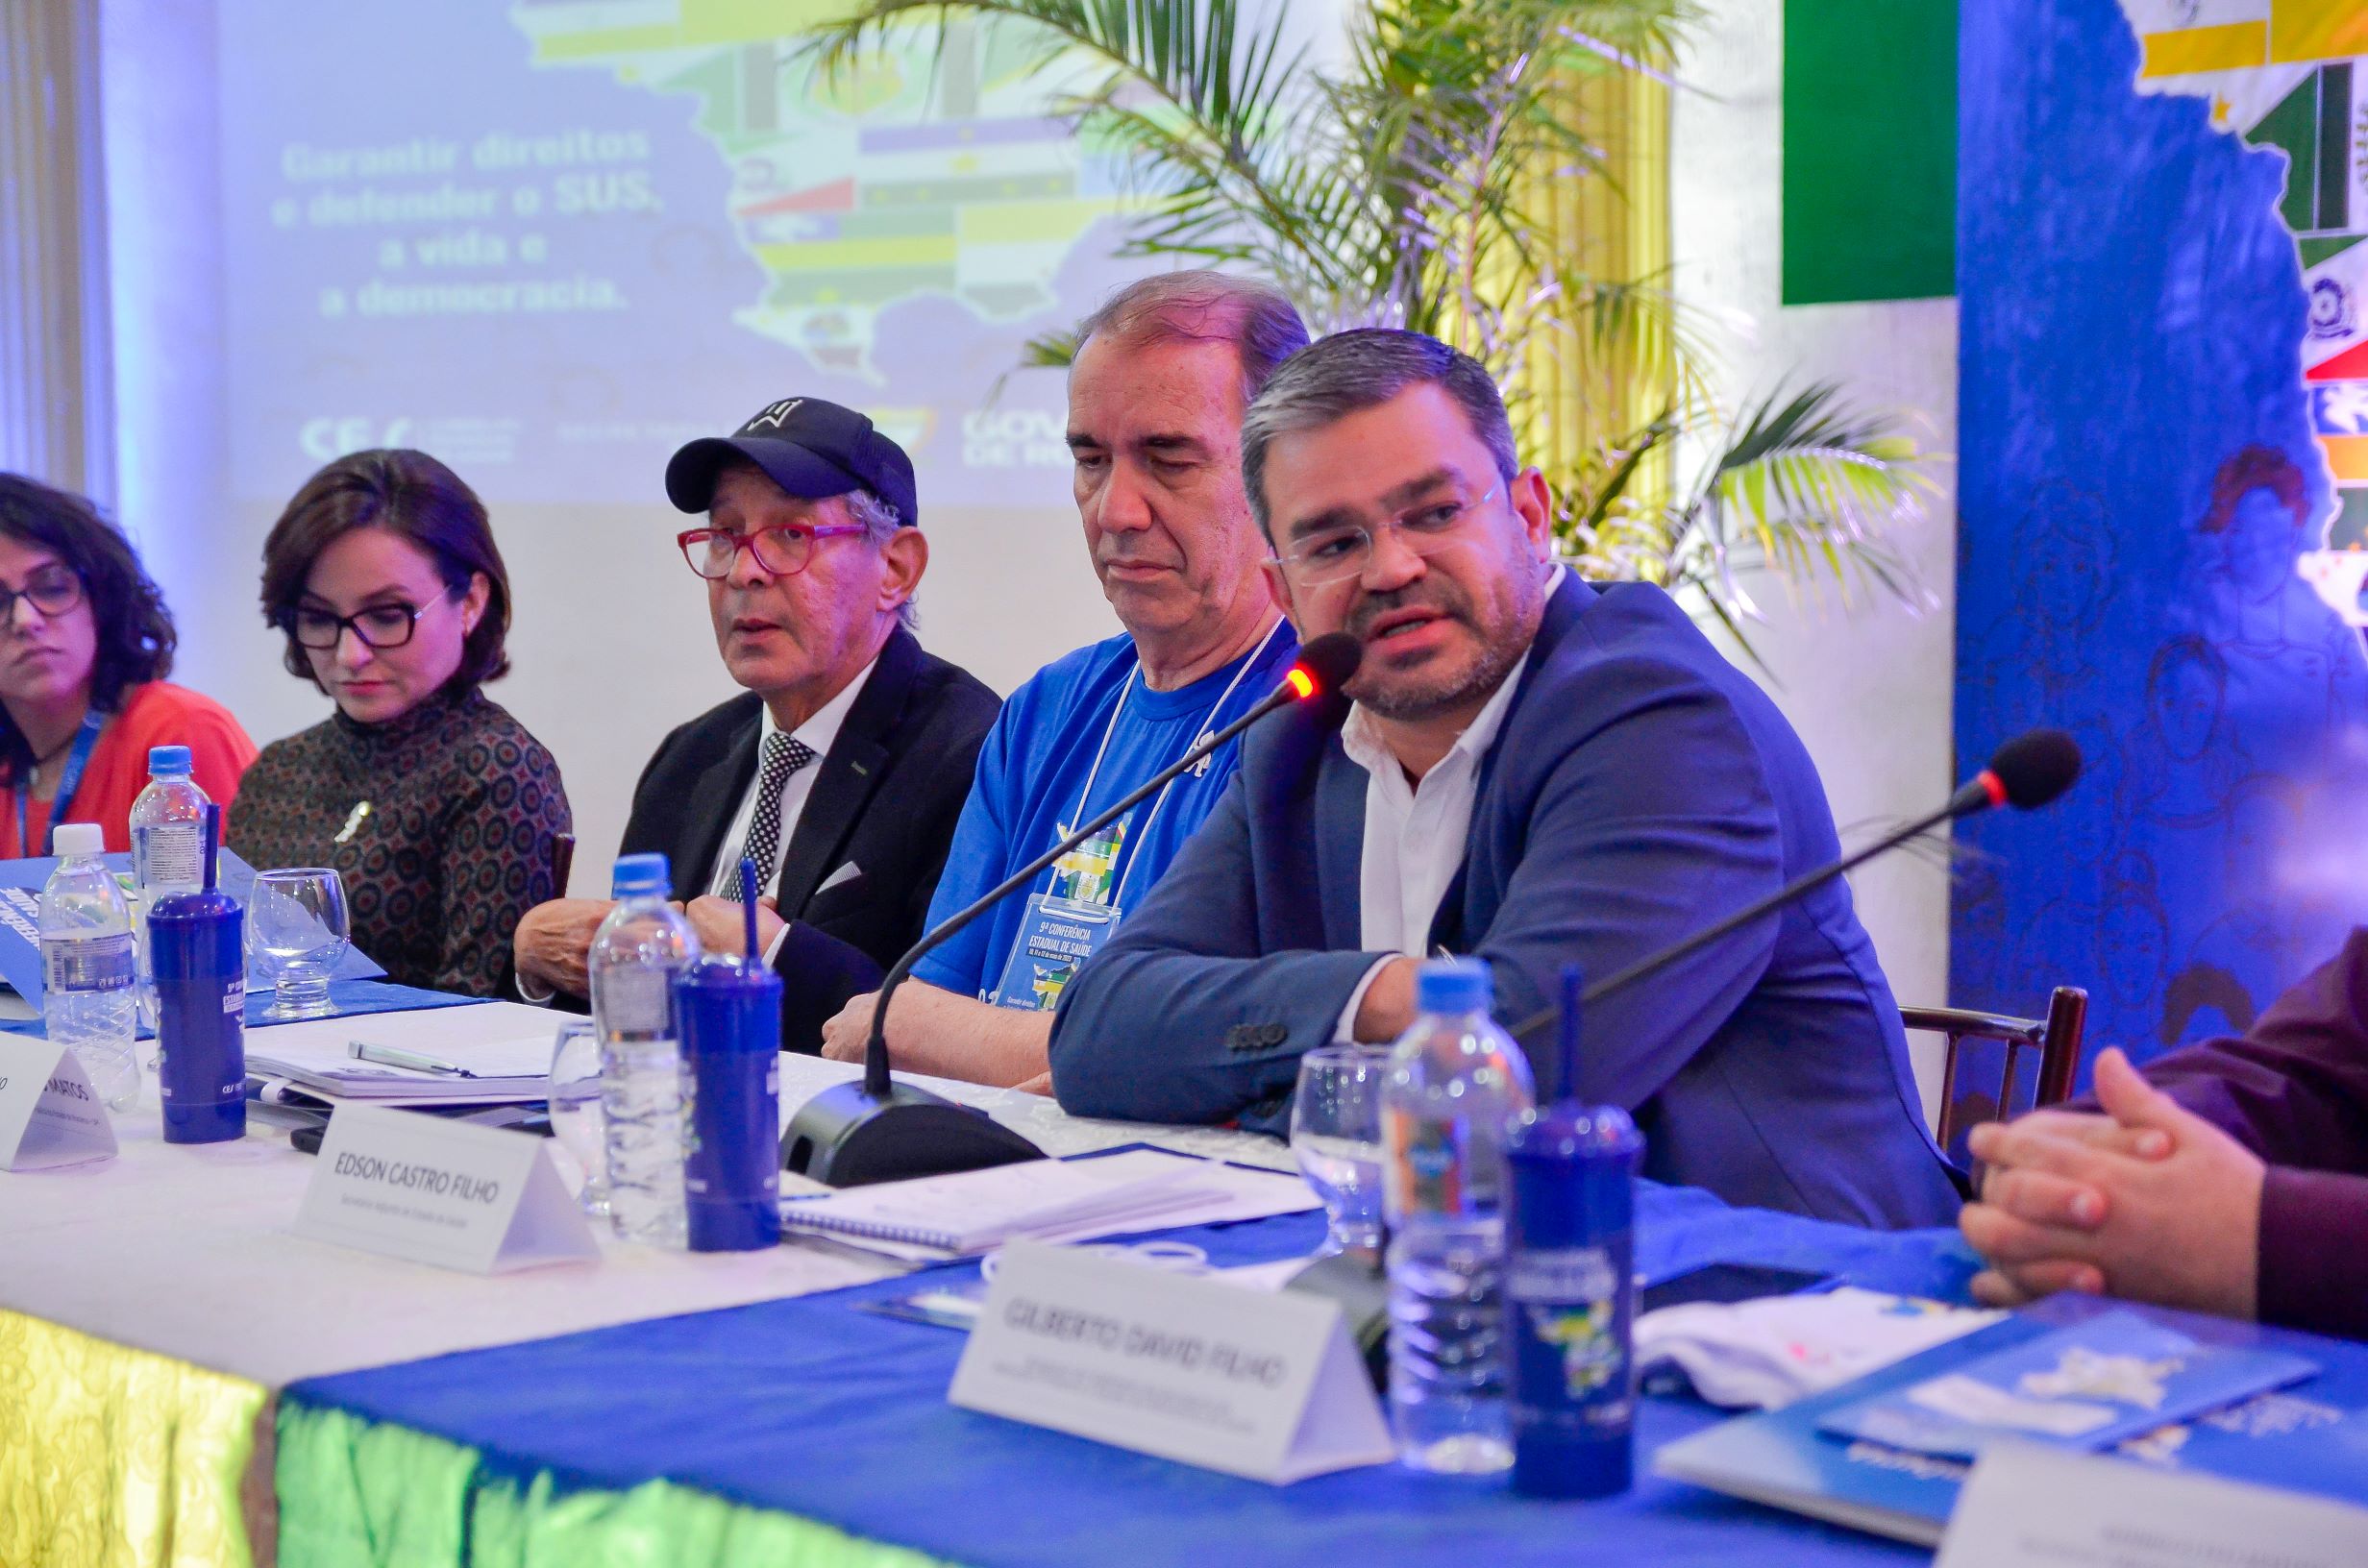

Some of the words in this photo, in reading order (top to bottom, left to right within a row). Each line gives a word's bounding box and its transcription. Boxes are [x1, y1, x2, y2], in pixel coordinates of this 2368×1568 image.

[284, 139, 457, 181] Garantir
[472, 130, 650, 170] direitos
[308, 183, 498, 226] defender
[415, 228, 507, 267] vida
[1028, 935, 1059, 951] ESTADUAL
[1060, 941, 1072, 953] DE
[1070, 941, 1092, 957] SAÚDE
[1048, 923, 1091, 941] CONFERÊNCIA
[334, 1152, 387, 1181] EDSON
[388, 1163, 449, 1193] CASTRO
[451, 1174, 499, 1204] FILHO
[1003, 1296, 1119, 1353] GILBERTO
